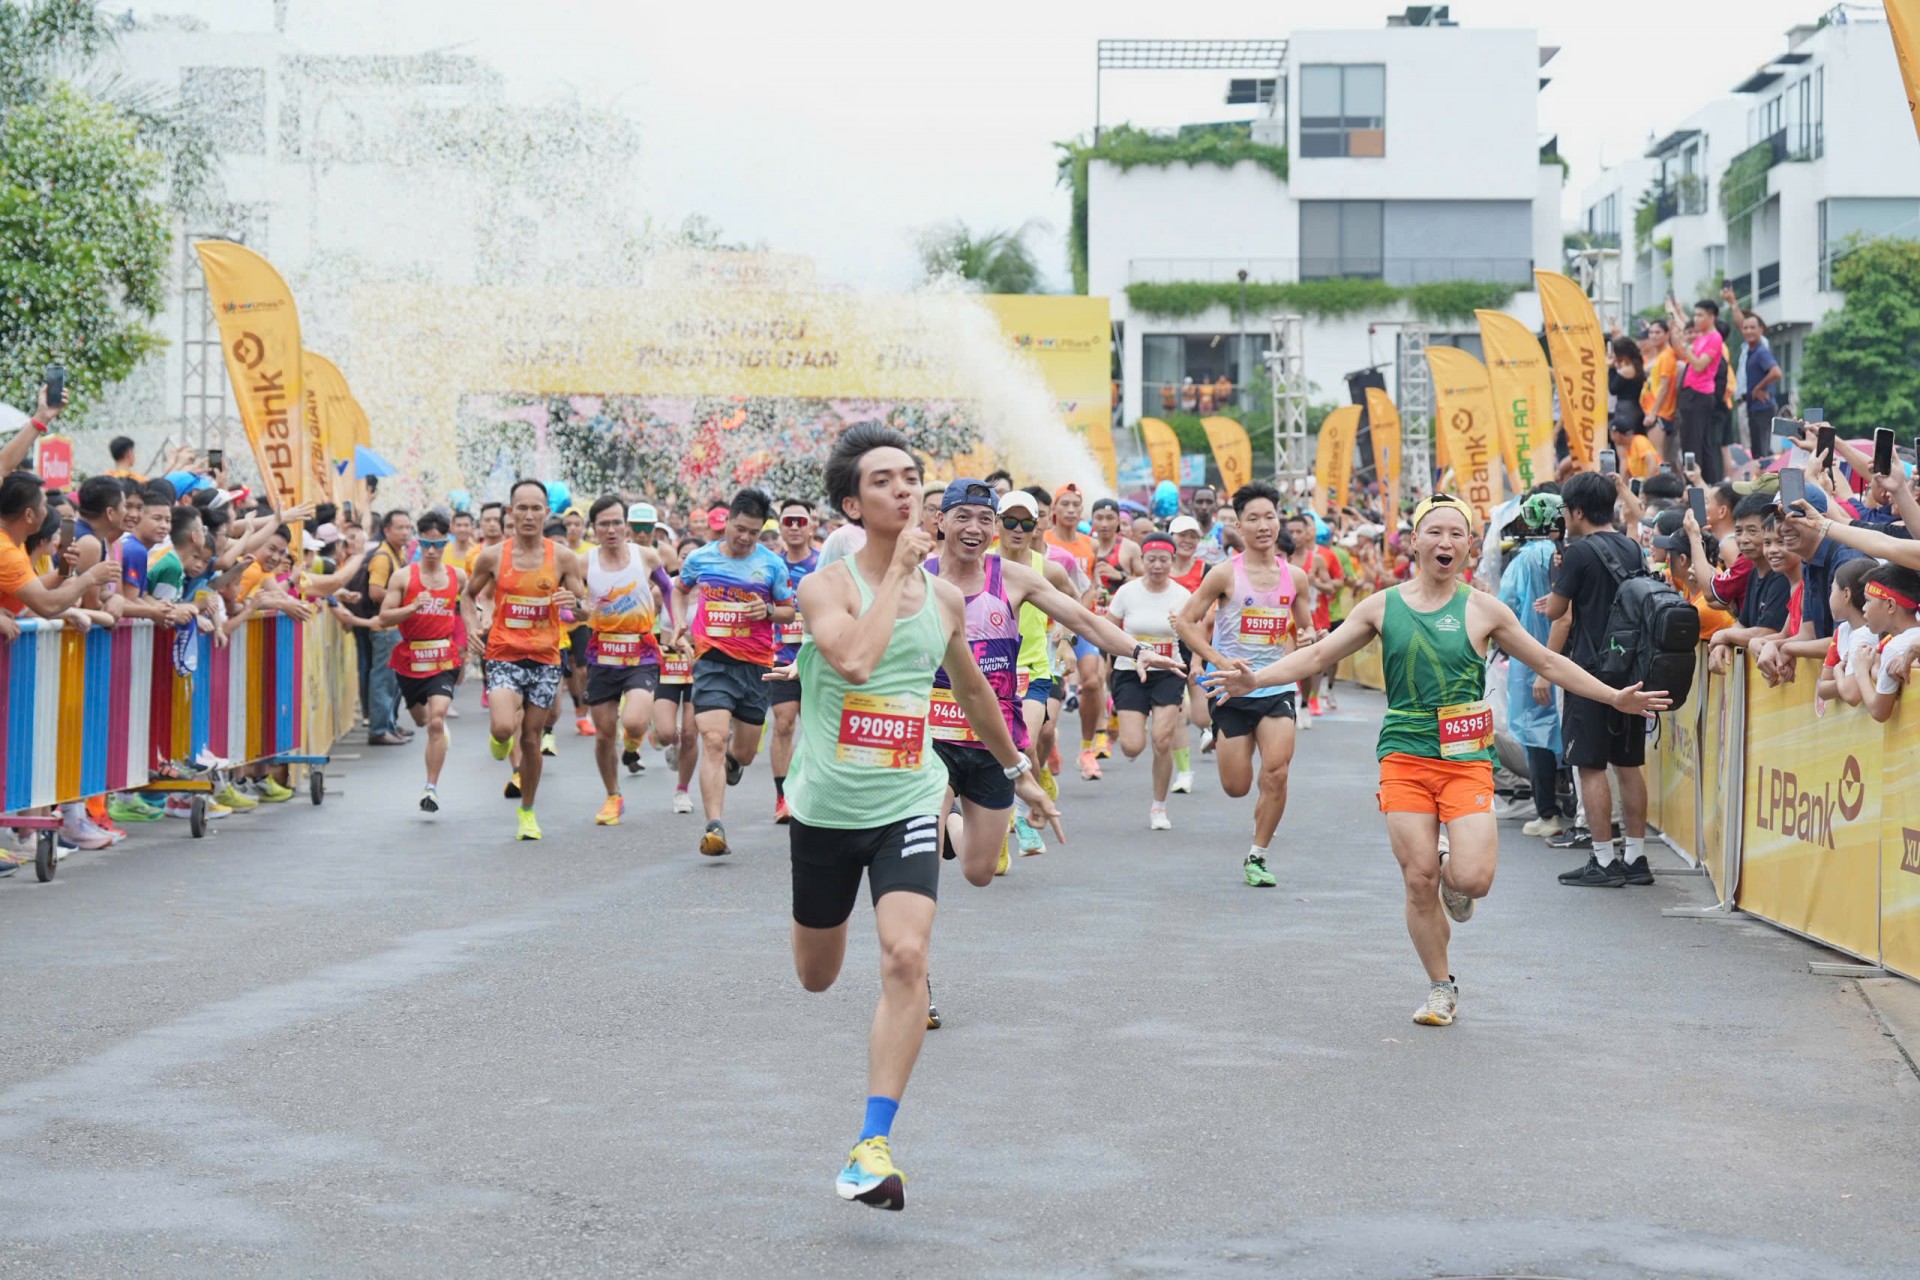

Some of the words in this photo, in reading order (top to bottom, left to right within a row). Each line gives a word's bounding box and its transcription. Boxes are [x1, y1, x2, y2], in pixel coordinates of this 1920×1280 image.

[1579, 347, 1597, 413] GIAN
[1515, 432, 1536, 492] HANH
[511, 604, 536, 616] 99114
[707, 611, 737, 623] 99909
[1246, 618, 1274, 629] 95195
[602, 643, 627, 653] 99168
[933, 703, 966, 719] 9460
[848, 715, 905, 739] 99098
[1445, 716, 1484, 735] 96395
[1756, 765, 1836, 850] LPBank
